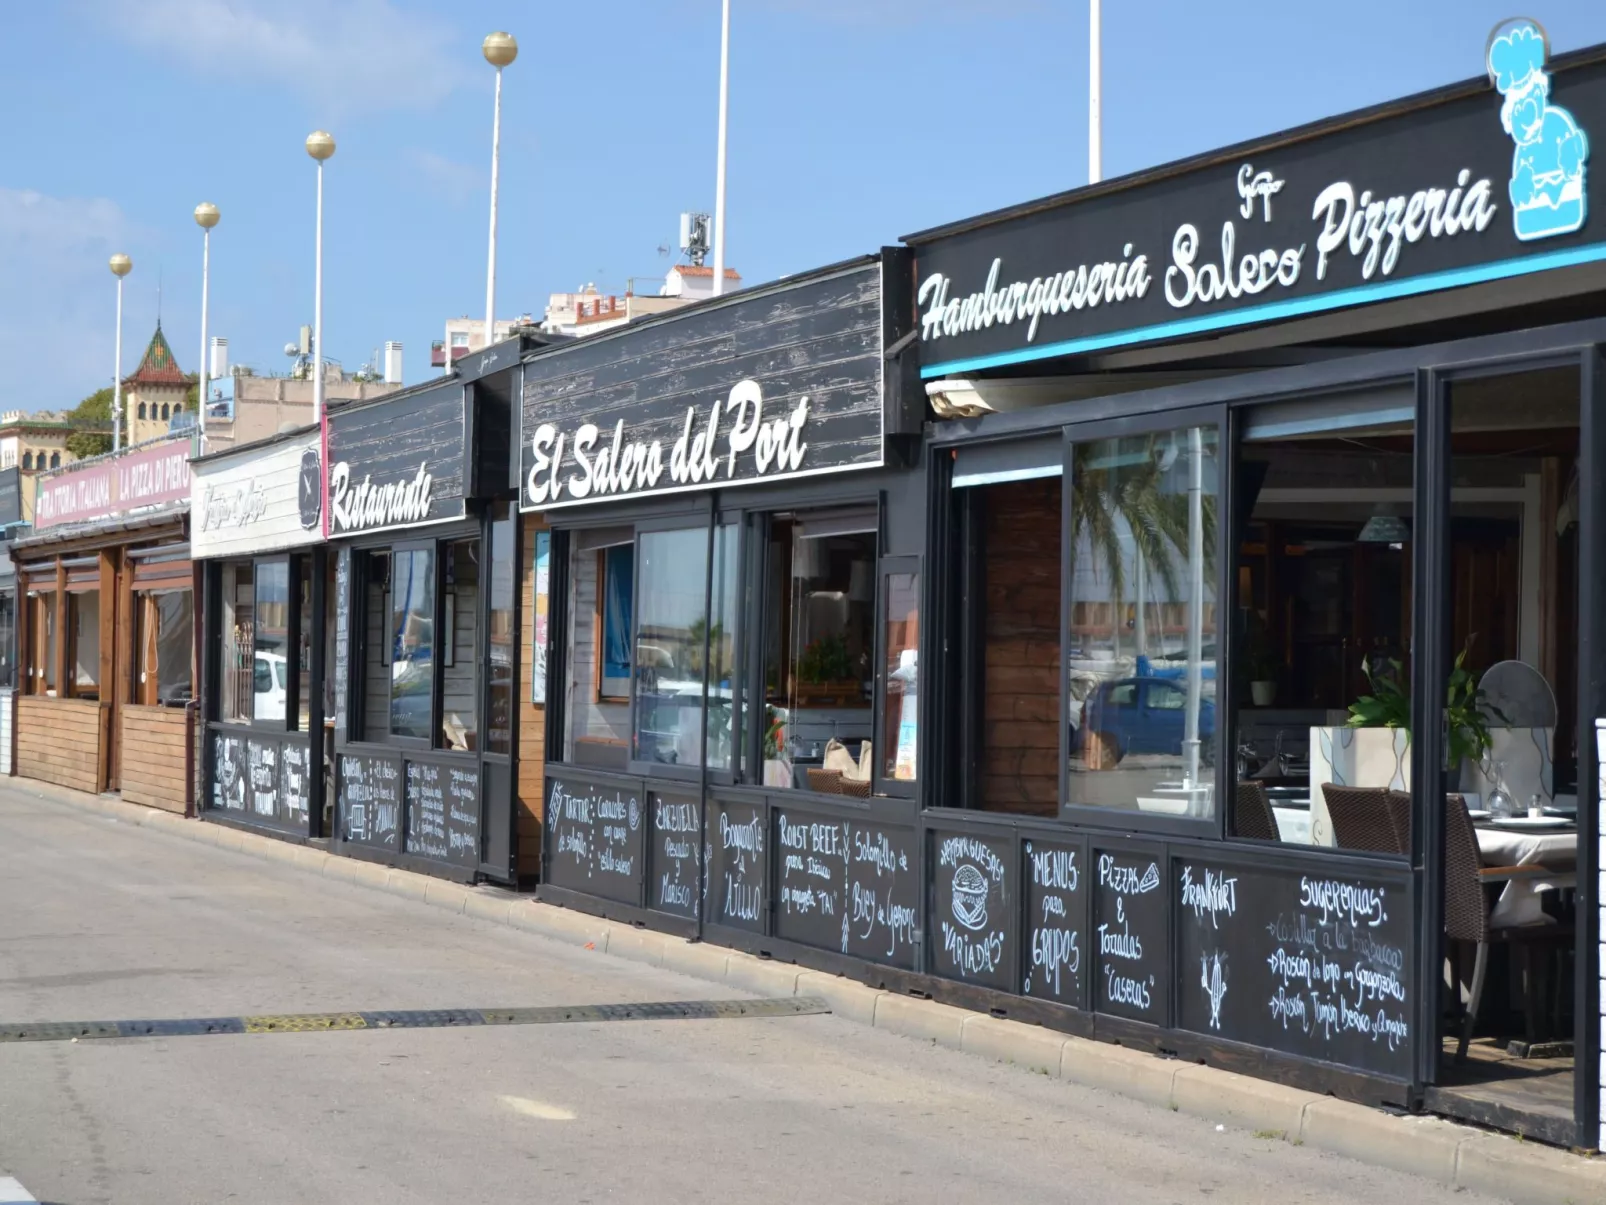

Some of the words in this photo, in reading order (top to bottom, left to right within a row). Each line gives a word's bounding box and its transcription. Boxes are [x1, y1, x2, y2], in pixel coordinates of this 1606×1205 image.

[1312, 168, 1497, 281] Pizzeria
[528, 423, 567, 504] El
[569, 418, 663, 499] Salero
[670, 400, 721, 484] del
[726, 379, 809, 480] Port
[120, 469, 130, 502] LA
[131, 462, 154, 499] PIZZA
[155, 458, 165, 494] DI
[331, 460, 432, 532] Restaurante
[809, 822, 839, 855] BEEF
